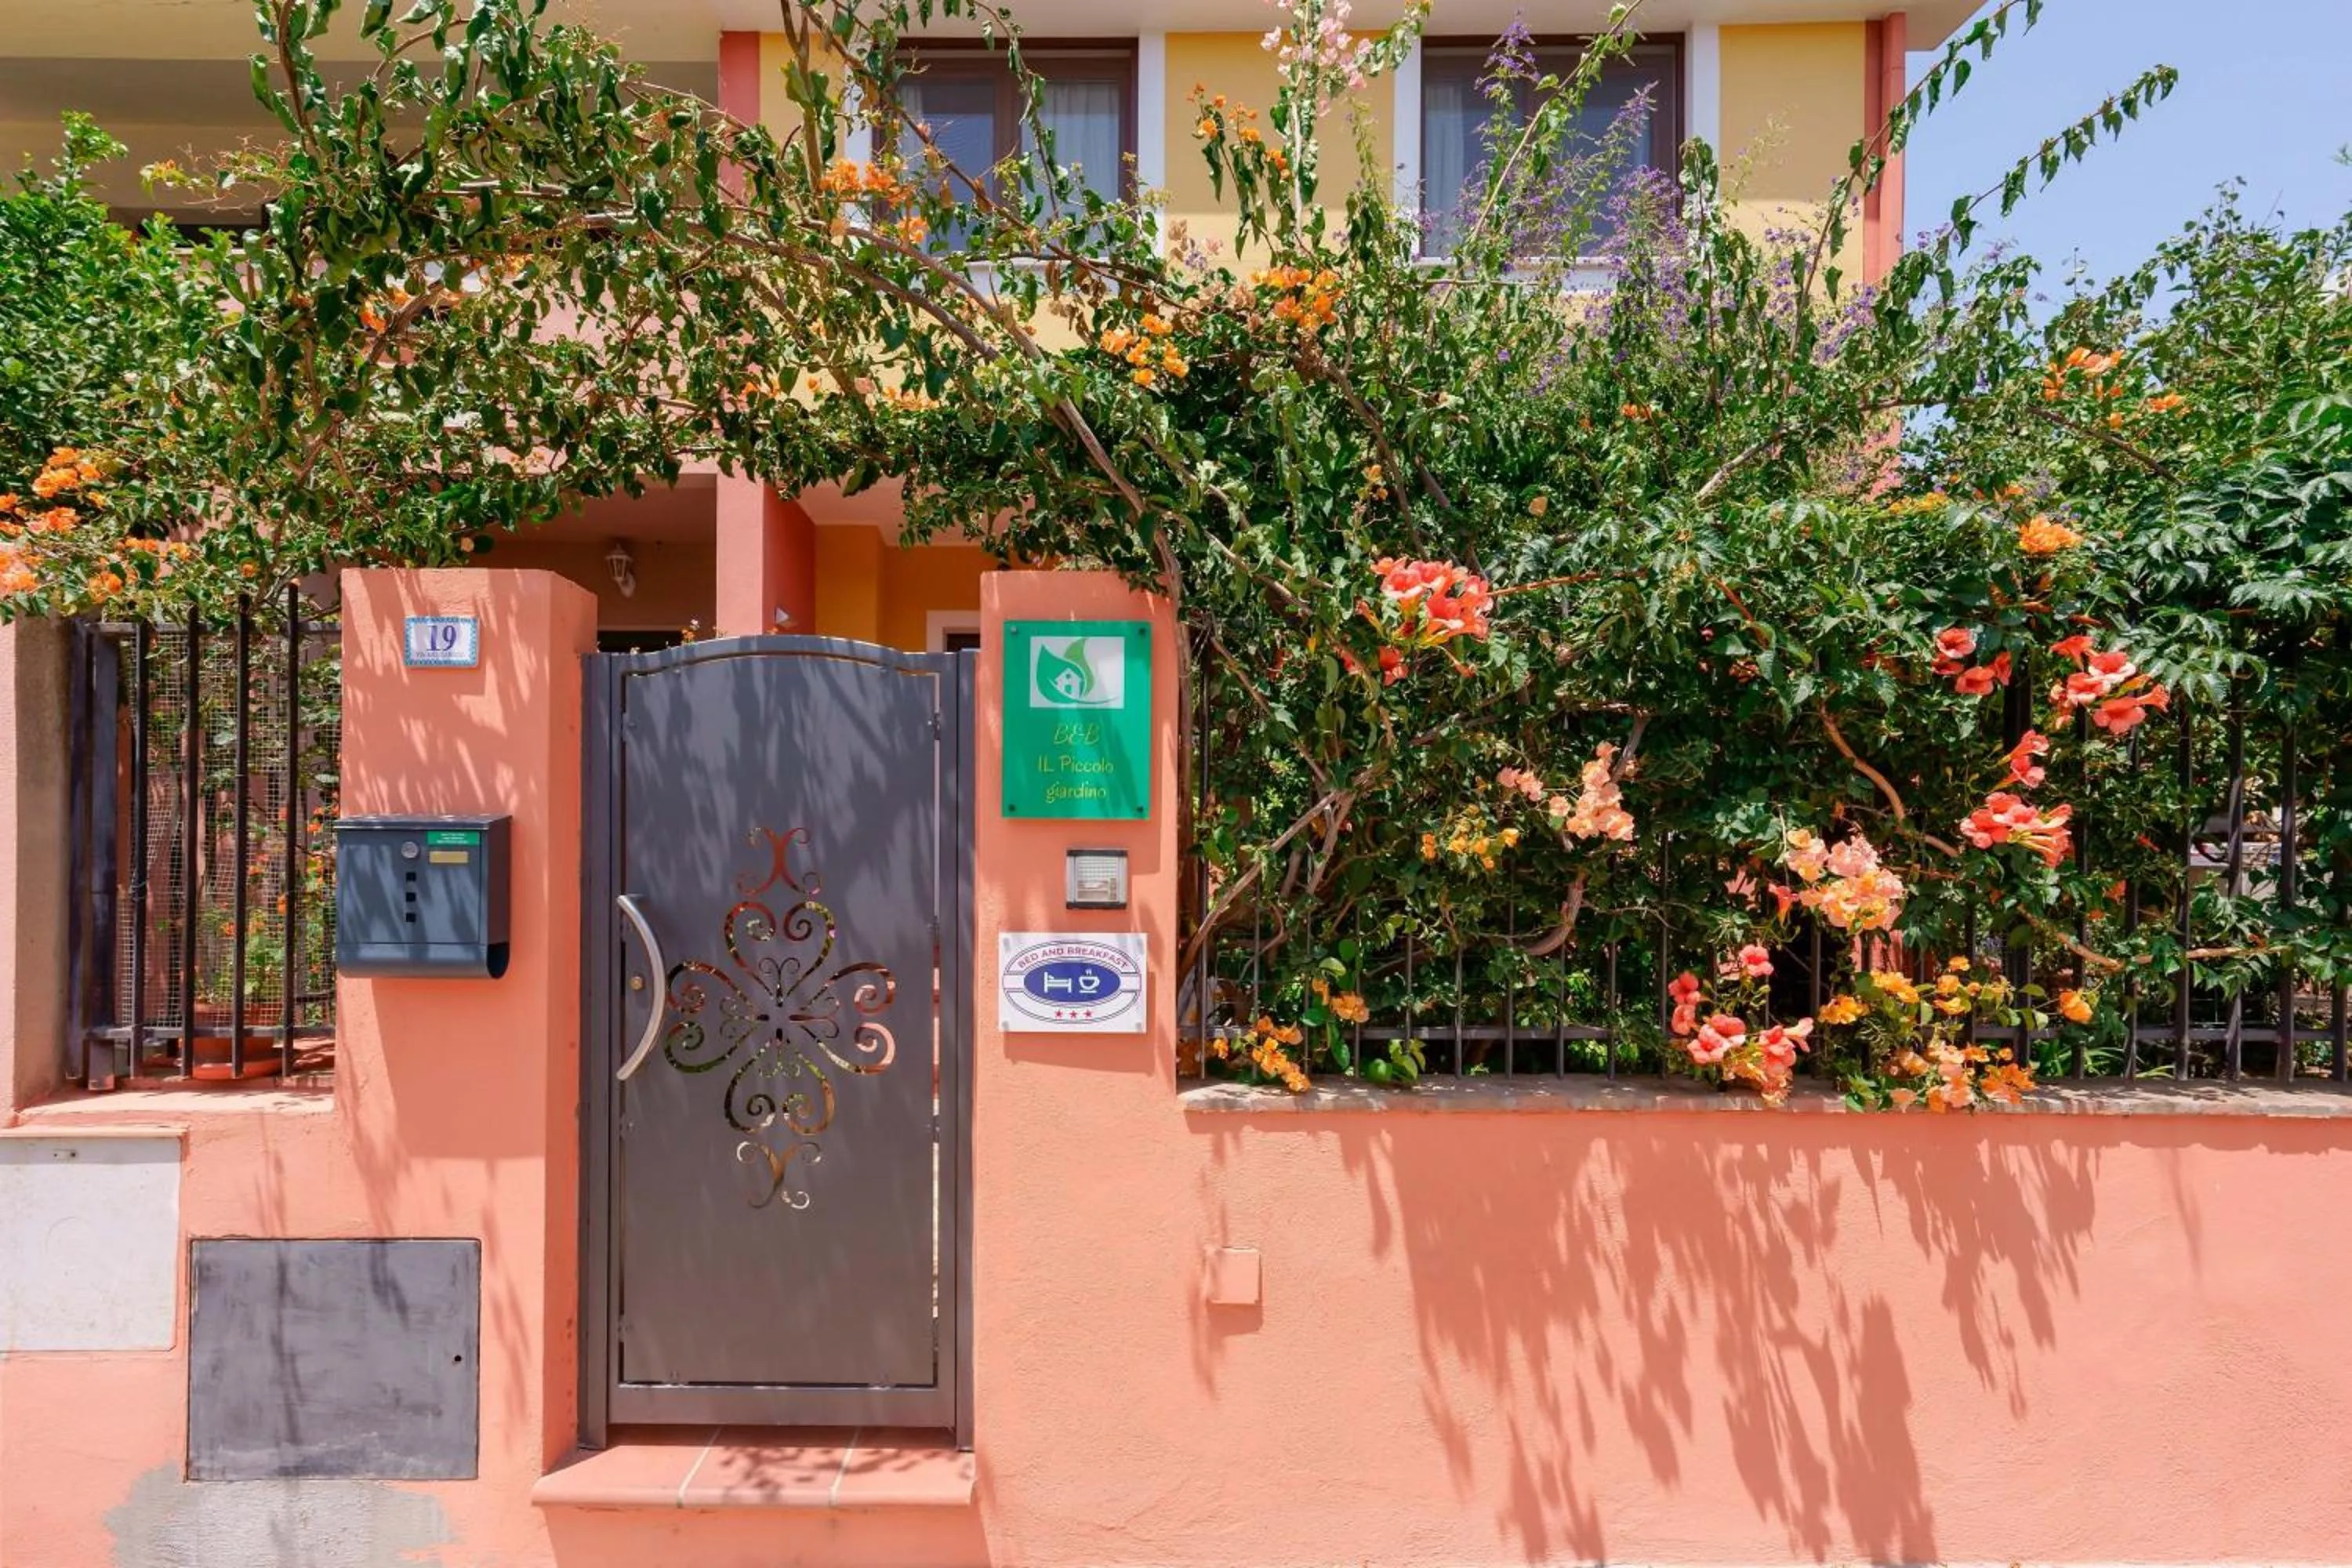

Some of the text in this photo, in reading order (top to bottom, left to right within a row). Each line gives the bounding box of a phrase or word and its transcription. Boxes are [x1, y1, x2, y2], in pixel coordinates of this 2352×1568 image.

[426, 625, 456, 652] 19
[1059, 754, 1114, 773] Piccolo
[1045, 780, 1106, 803] giardino
[1018, 946, 1128, 969] BED AND BREAKFAST
